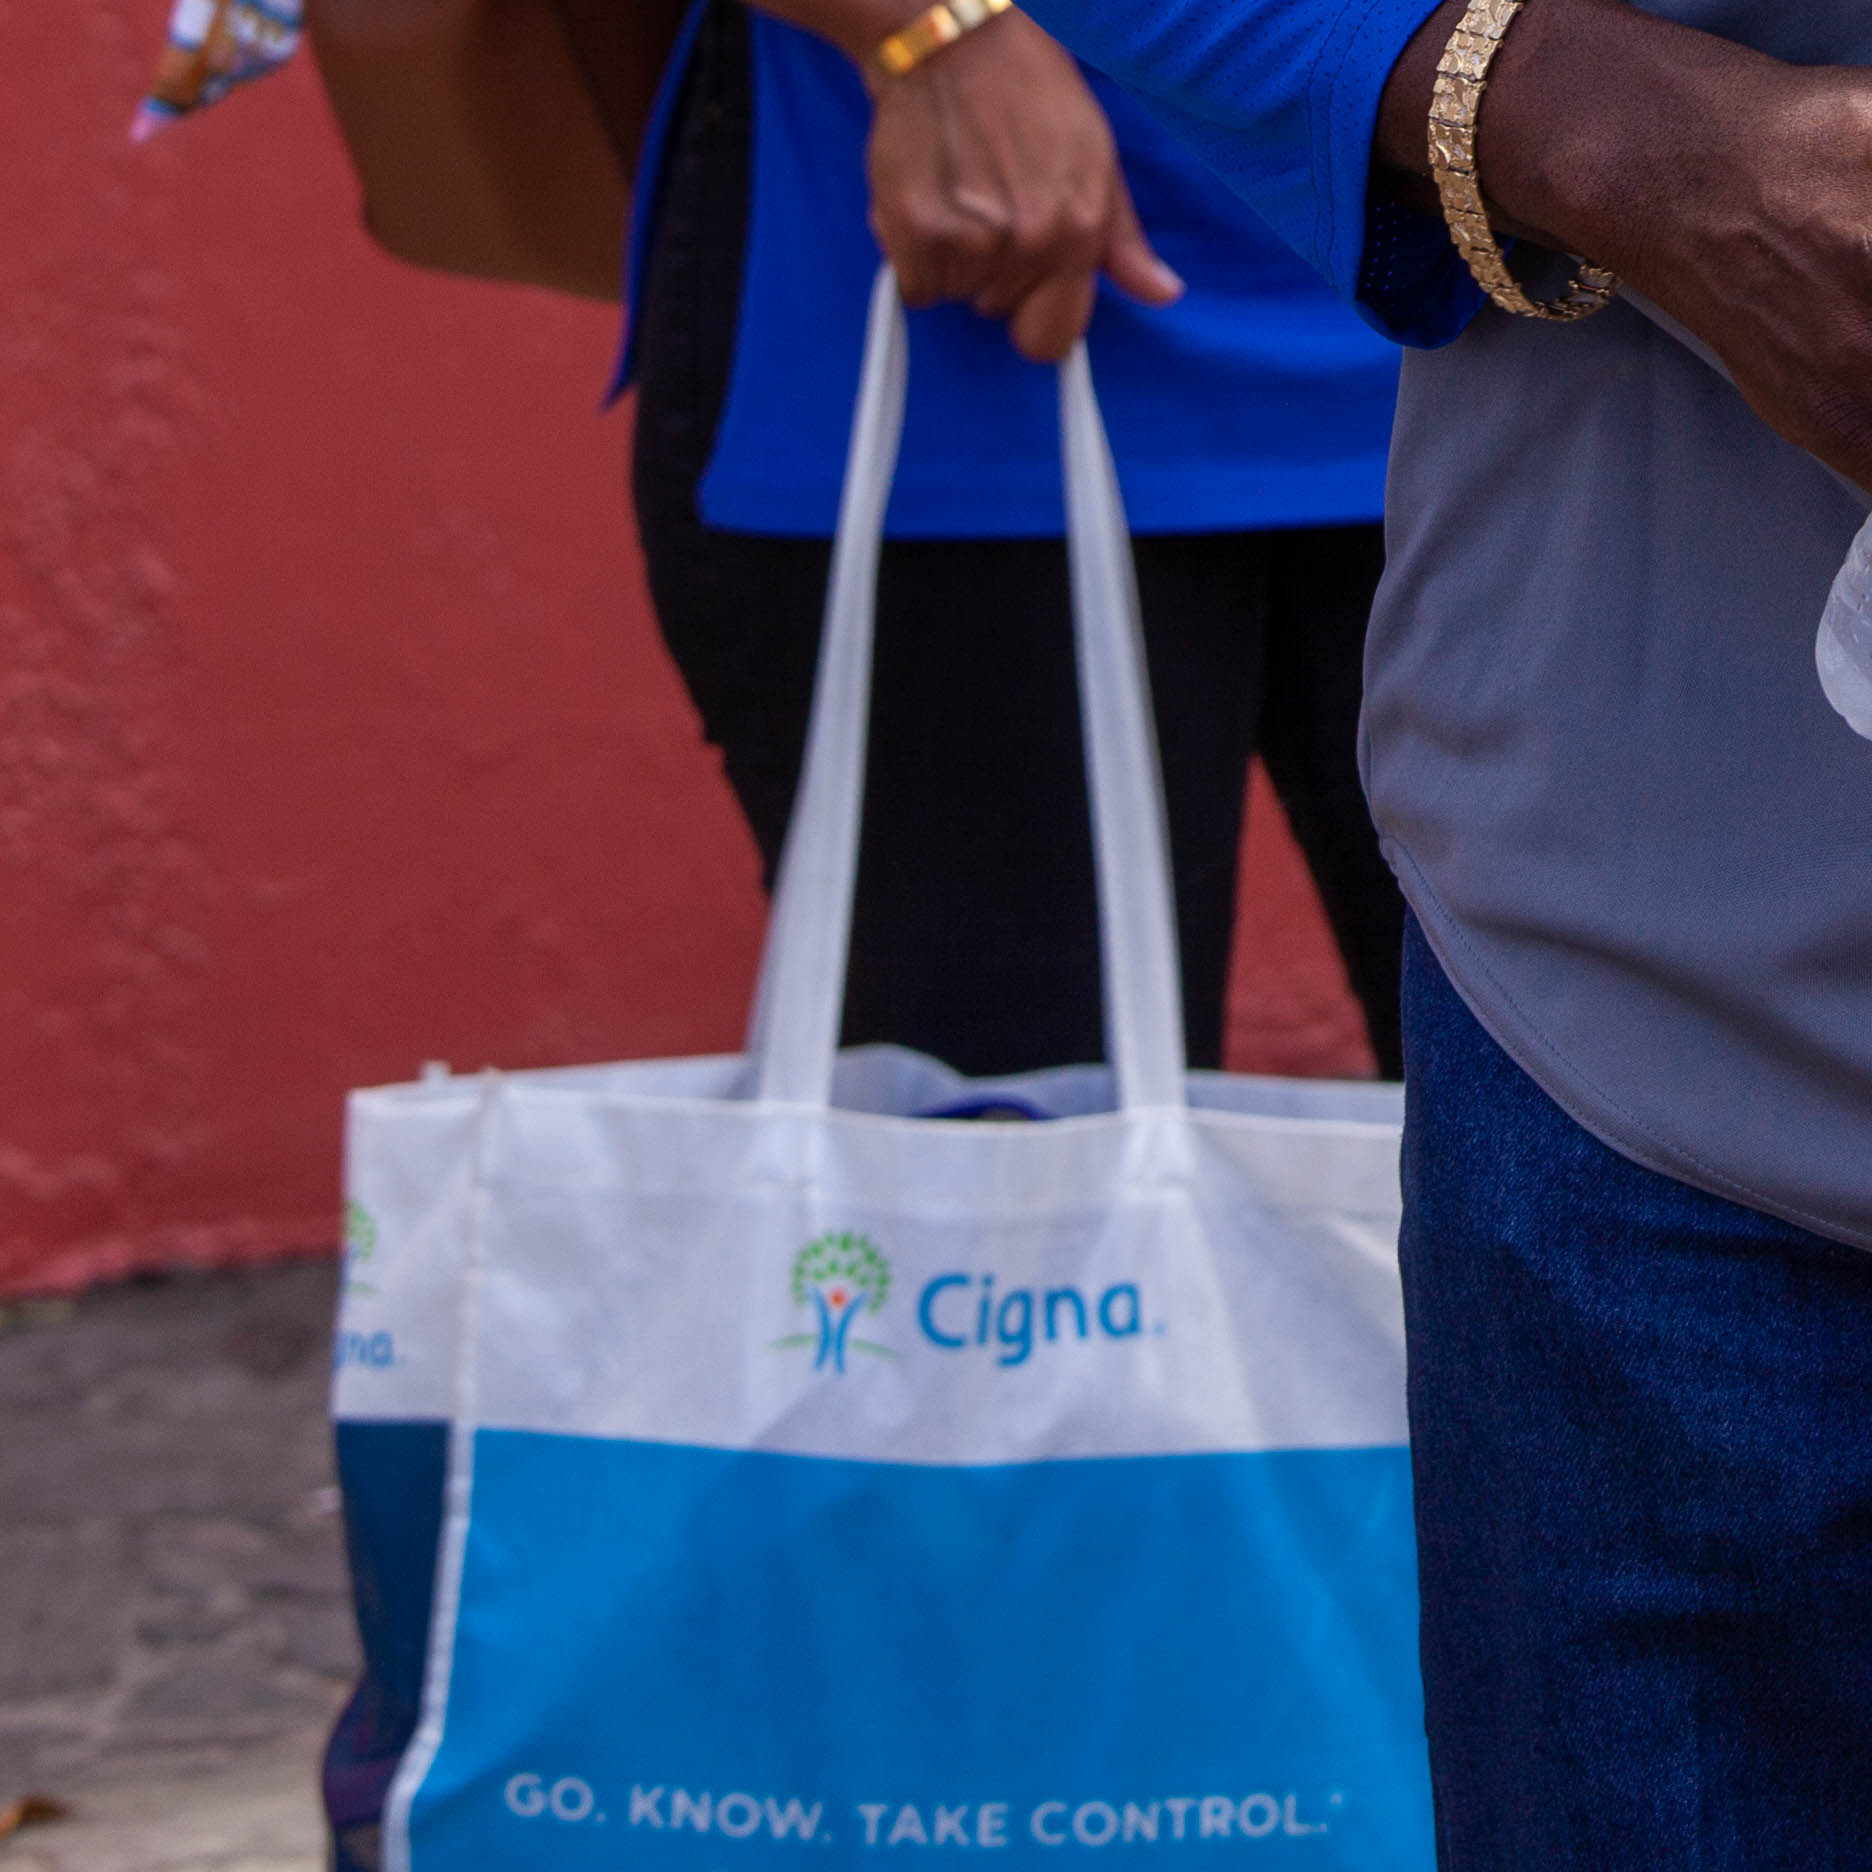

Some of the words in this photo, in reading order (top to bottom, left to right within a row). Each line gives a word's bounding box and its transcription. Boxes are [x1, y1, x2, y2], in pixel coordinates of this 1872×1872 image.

[503, 1771, 606, 1823] GO.
[627, 1783, 832, 1843] KNOW.
[857, 1801, 1009, 1848] TAKE
